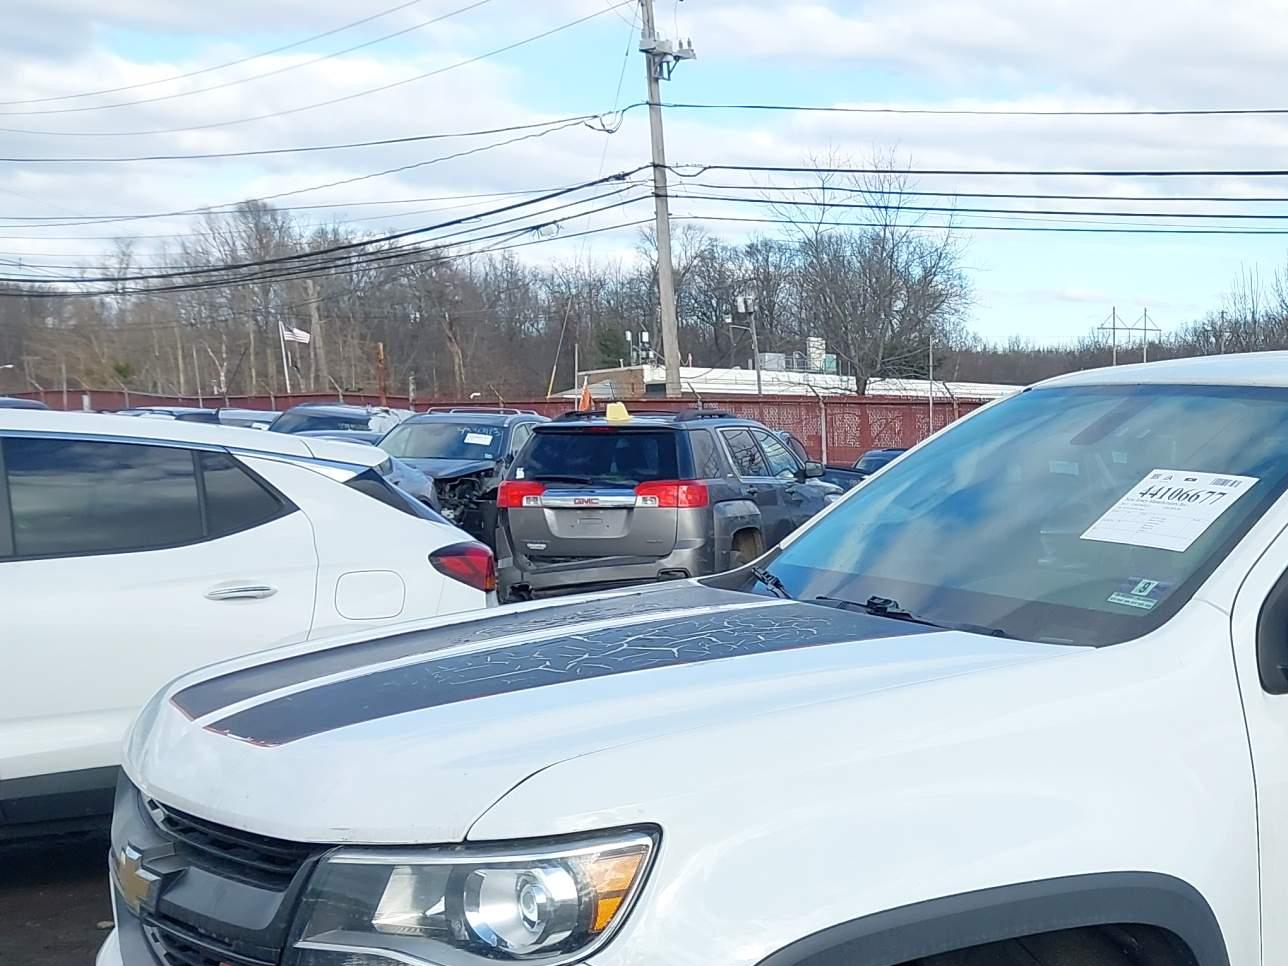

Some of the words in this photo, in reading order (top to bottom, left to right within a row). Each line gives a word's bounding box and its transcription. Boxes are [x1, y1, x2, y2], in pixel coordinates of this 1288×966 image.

[573, 497, 600, 506] GMC
[1138, 484, 1228, 506] 44106677
[1138, 581, 1152, 594] 9
